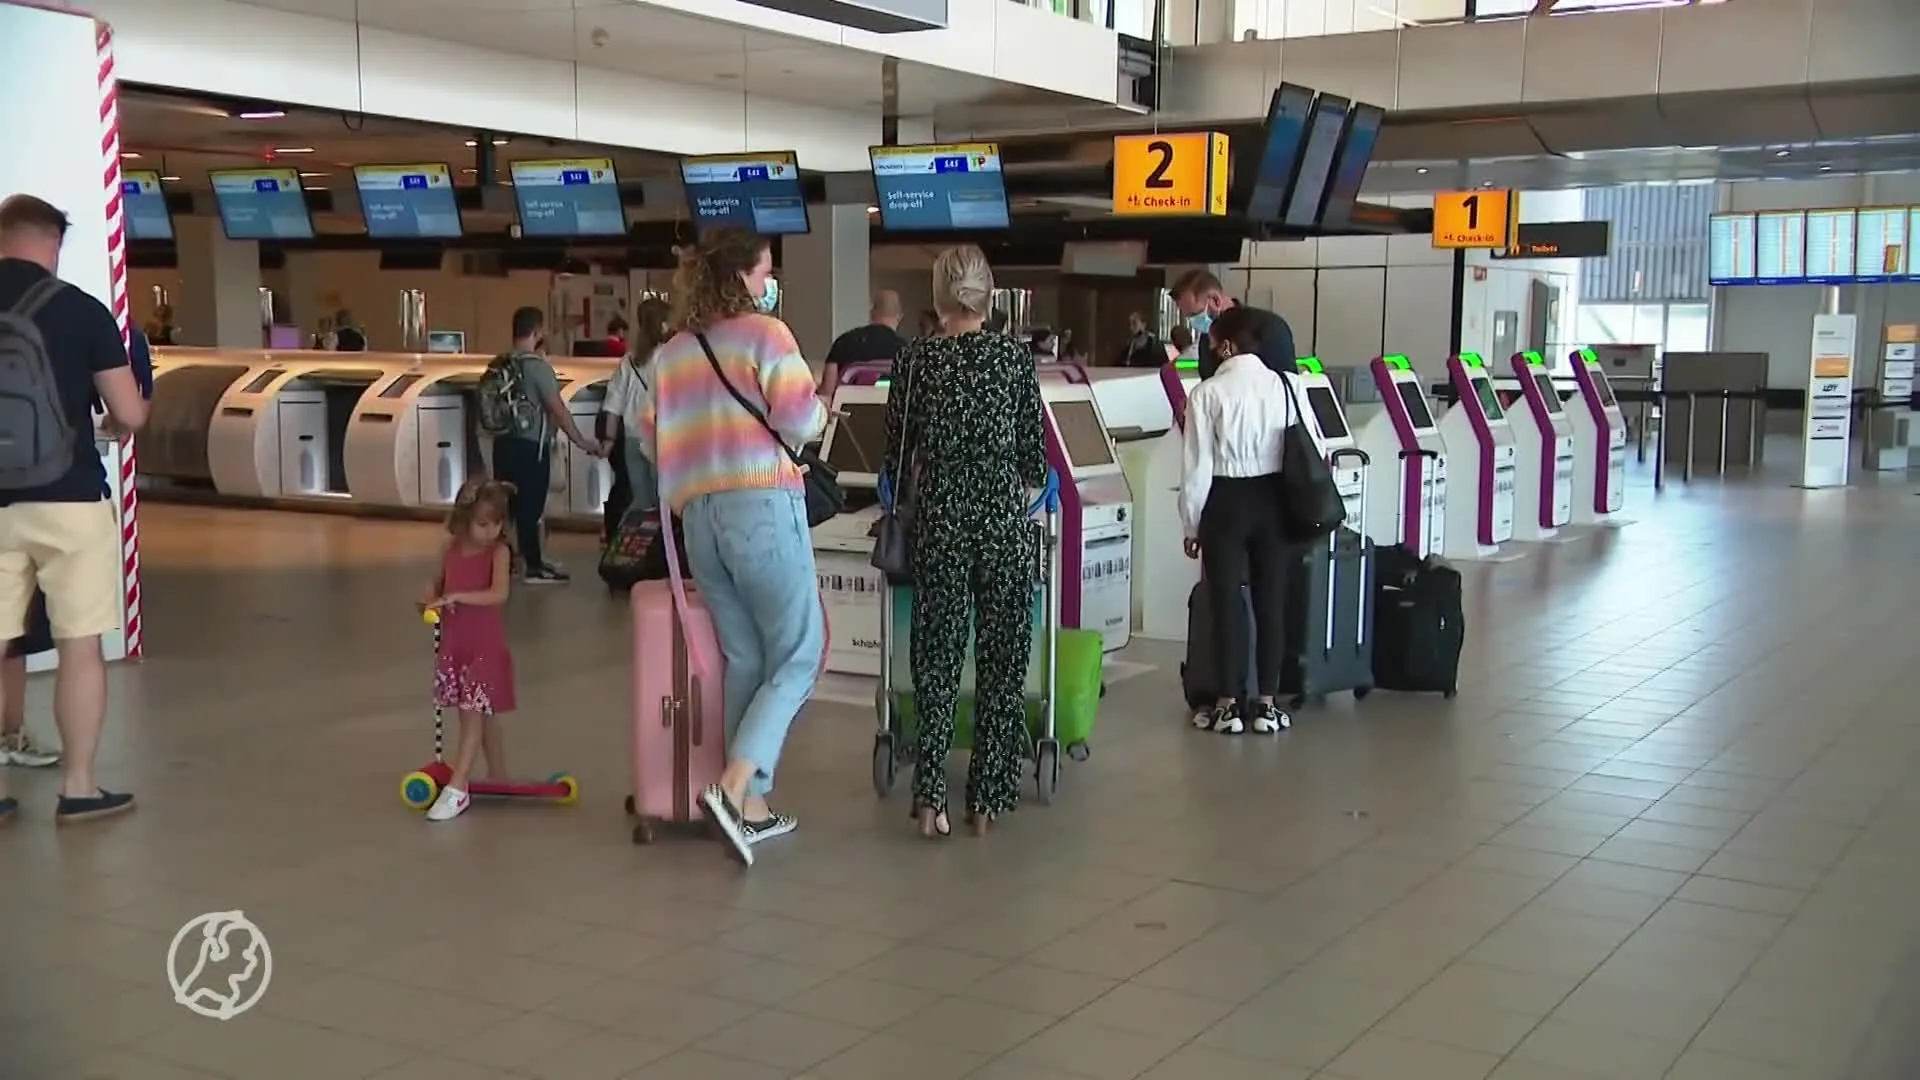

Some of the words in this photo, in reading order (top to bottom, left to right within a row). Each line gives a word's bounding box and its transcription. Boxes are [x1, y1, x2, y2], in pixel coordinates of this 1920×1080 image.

[1145, 141, 1174, 189] 2
[887, 191, 935, 201] Self-service
[1143, 195, 1191, 207] Check-in
[888, 200, 923, 211] drop-off
[1462, 195, 1479, 230] 1
[1457, 234, 1495, 243] Check-in
